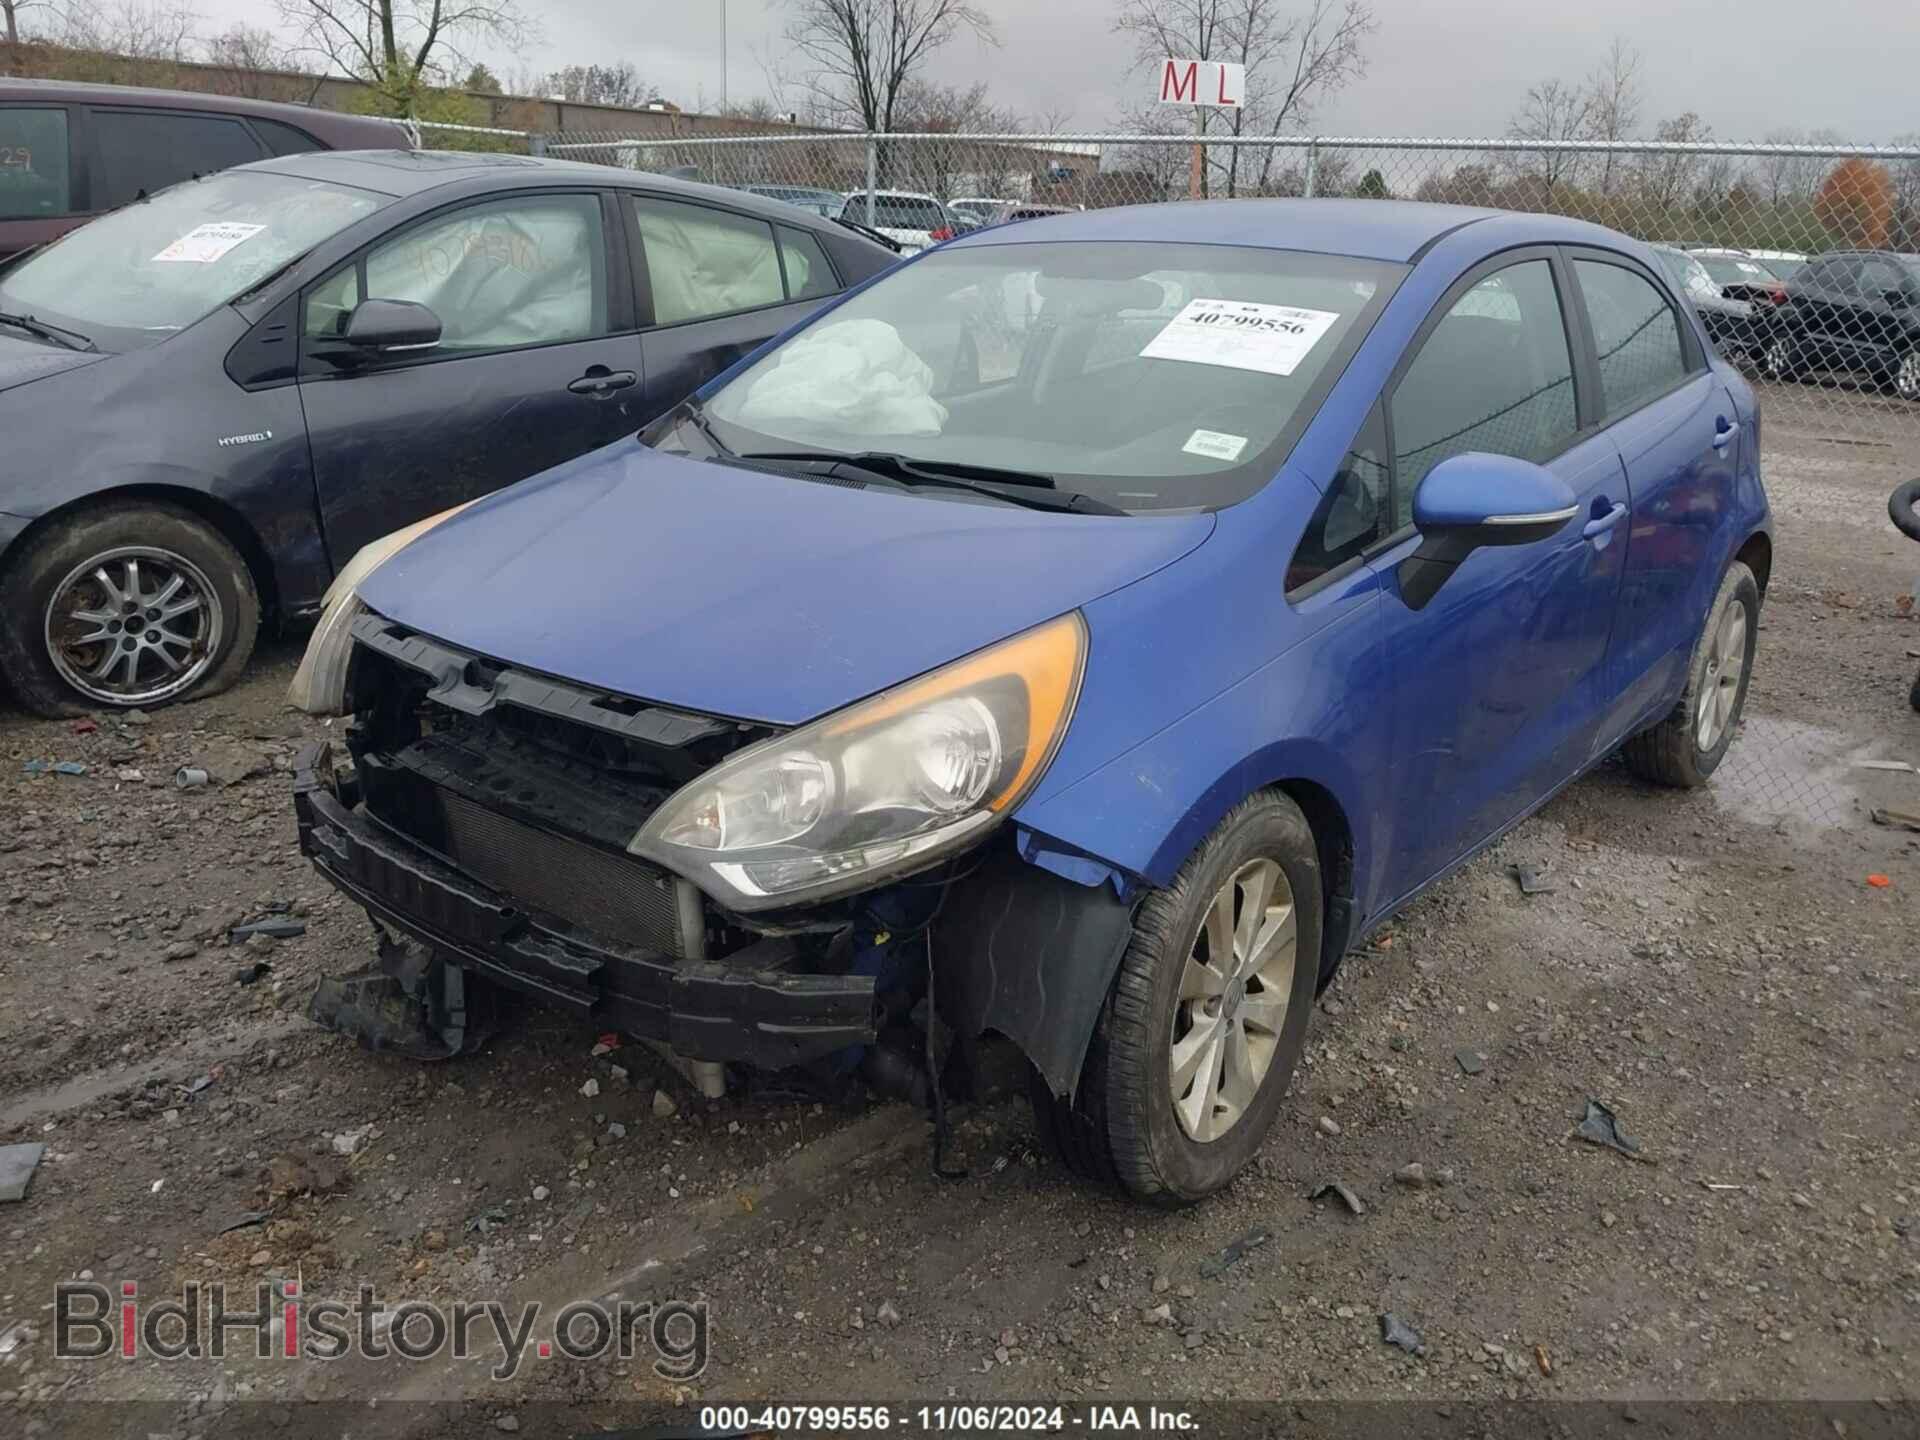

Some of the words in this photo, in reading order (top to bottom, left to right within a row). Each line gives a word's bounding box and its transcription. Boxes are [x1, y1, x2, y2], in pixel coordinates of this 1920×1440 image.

[1162, 61, 1197, 102] M
[1218, 64, 1235, 104] L
[1189, 311, 1305, 336] 40799556
[218, 433, 265, 447] HYBRID
